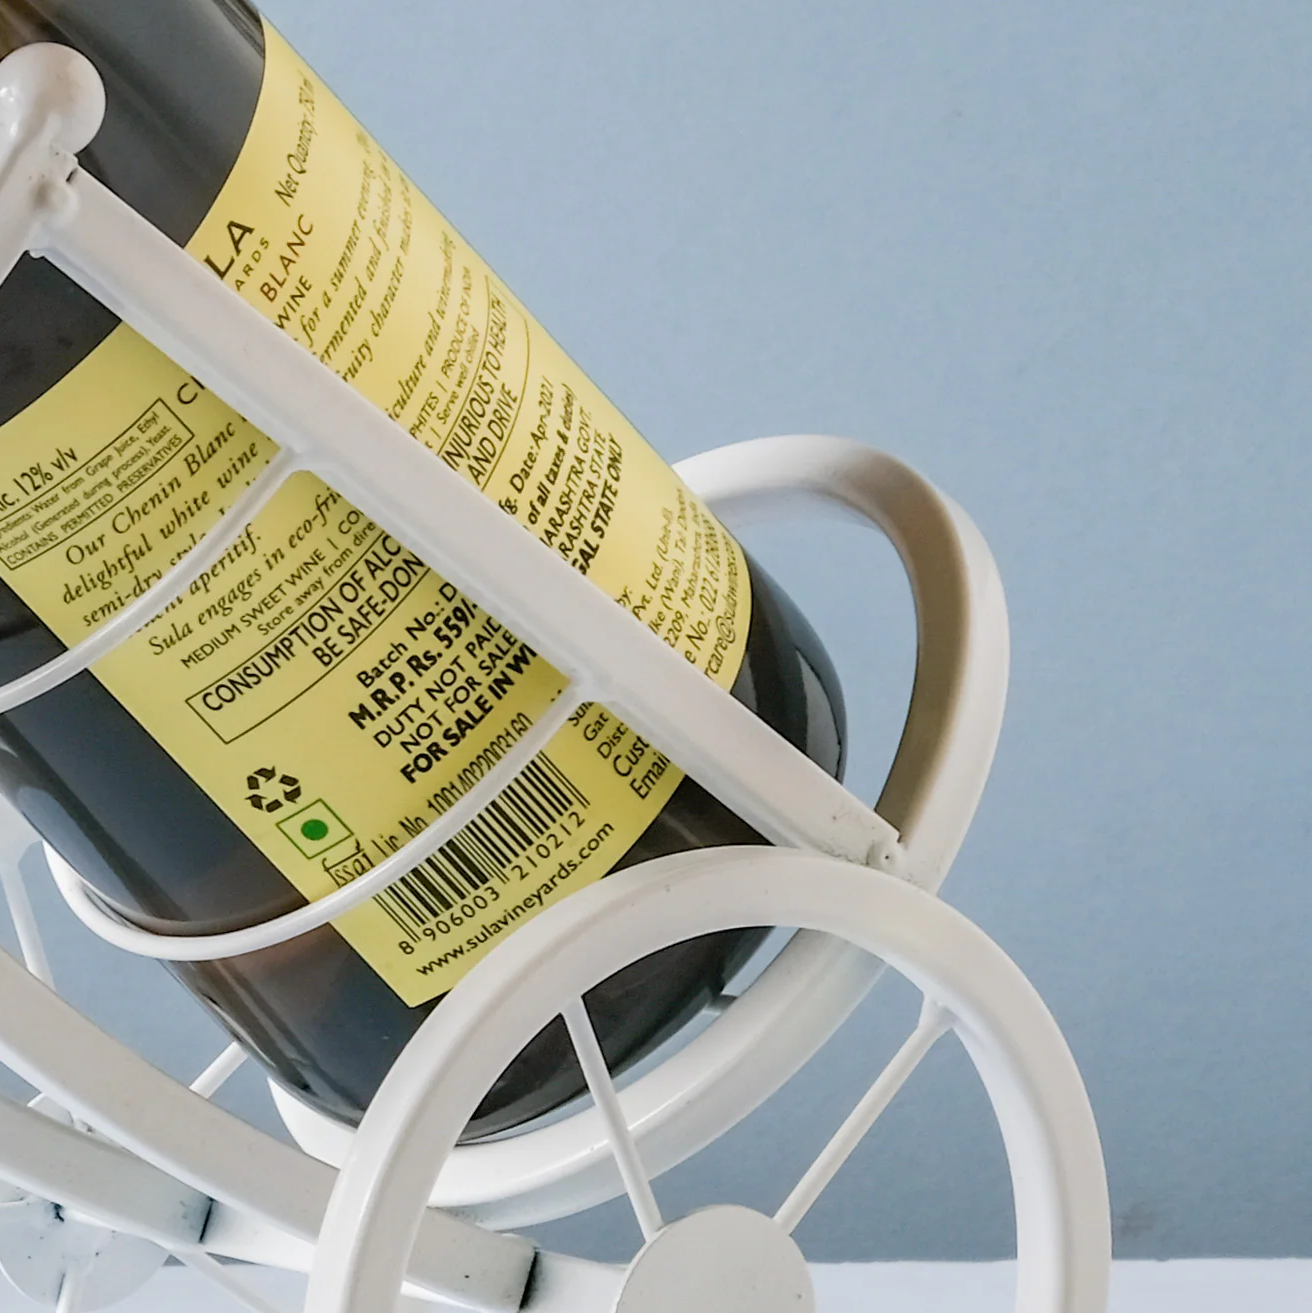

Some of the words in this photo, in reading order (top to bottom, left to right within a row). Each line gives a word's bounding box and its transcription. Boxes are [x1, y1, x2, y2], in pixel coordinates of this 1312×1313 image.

[203, 220, 255, 280] LA
[234, 237, 270, 291] ARDS
[259, 213, 314, 303] BLANC
[274, 274, 313, 330] WINE
[341, 338, 374, 383] ruity
[370, 255, 404, 338] character
[63, 533, 153, 605] delightful
[159, 490, 211, 540] white
[216, 441, 259, 489] wine
[320, 276, 368, 365] ermented
[365, 236, 382, 282] and
[65, 533, 107, 566] Our
[111, 476, 182, 534] Chenin
[182, 421, 236, 478] Blanc
[299, 307, 321, 348] for
[322, 289, 332, 309] a
[329, 218, 362, 292] summer
[408, 391, 440, 440] PHITES
[6, 531, 60, 566] CONTAINS
[60, 492, 115, 535] PERMITTED
[115, 433, 184, 493] PRESERVATIVES
[12, 462, 54, 496] 12%
[50, 447, 78, 472] v/v
[31, 493, 62, 514] Water
[61, 476, 86, 494] from
[85, 454, 114, 477] Grape
[82, 477, 113, 502] during
[148, 623, 193, 656] Sula
[198, 567, 263, 626] engages
[264, 547, 286, 572] in
[387, 354, 427, 423] iculture
[425, 310, 441, 358] and
[257, 604, 295, 636] Store
[293, 576, 325, 607] away
[322, 547, 354, 578] from
[352, 521, 377, 547] dire
[436, 390, 460, 425] Serve
[311, 636, 345, 668] BE
[337, 550, 426, 645] SAFE-DON
[467, 436, 497, 486] AND
[487, 381, 518, 442] DRIVE
[528, 500, 541, 526] of
[537, 481, 552, 508] all
[544, 444, 566, 486] taxes
[189, 523, 261, 595] aperitif.
[202, 597, 344, 712] CONSUMPTION
[338, 570, 367, 603] OF
[364, 535, 402, 580] ALC
[441, 374, 495, 472] INJURIOUS
[482, 350, 502, 381] TO
[356, 642, 409, 688] Batch
[498, 496, 518, 516] fg.
[399, 709, 444, 755] NOT
[443, 675, 483, 714] FOR
[478, 628, 518, 677] SALE
[558, 479, 598, 561] RASHTRA
[589, 428, 606, 480] STATE
[180, 622, 241, 670] MEDIUM
[240, 583, 288, 628] SWEET
[284, 547, 327, 588] WINE
[373, 697, 426, 748] DUTY
[425, 655, 467, 702] NOT
[540, 455, 587, 548] ARASHTRA
[400, 741, 449, 784] FOR
[442, 694, 494, 748] SALE
[488, 670, 515, 700] IN
[590, 480, 619, 539] STATE
[606, 432, 623, 483] ONLY
[348, 671, 415, 730] M.R.P.
[406, 650, 443, 678] Rs.
[583, 711, 611, 742] Gat
[648, 610, 667, 636] lke
[613, 735, 651, 777] Cust
[398, 939, 415, 955] 8
[422, 886, 501, 941] 906003
[511, 811, 586, 882] 210212
[416, 821, 616, 977] www.sulavineyards.com
